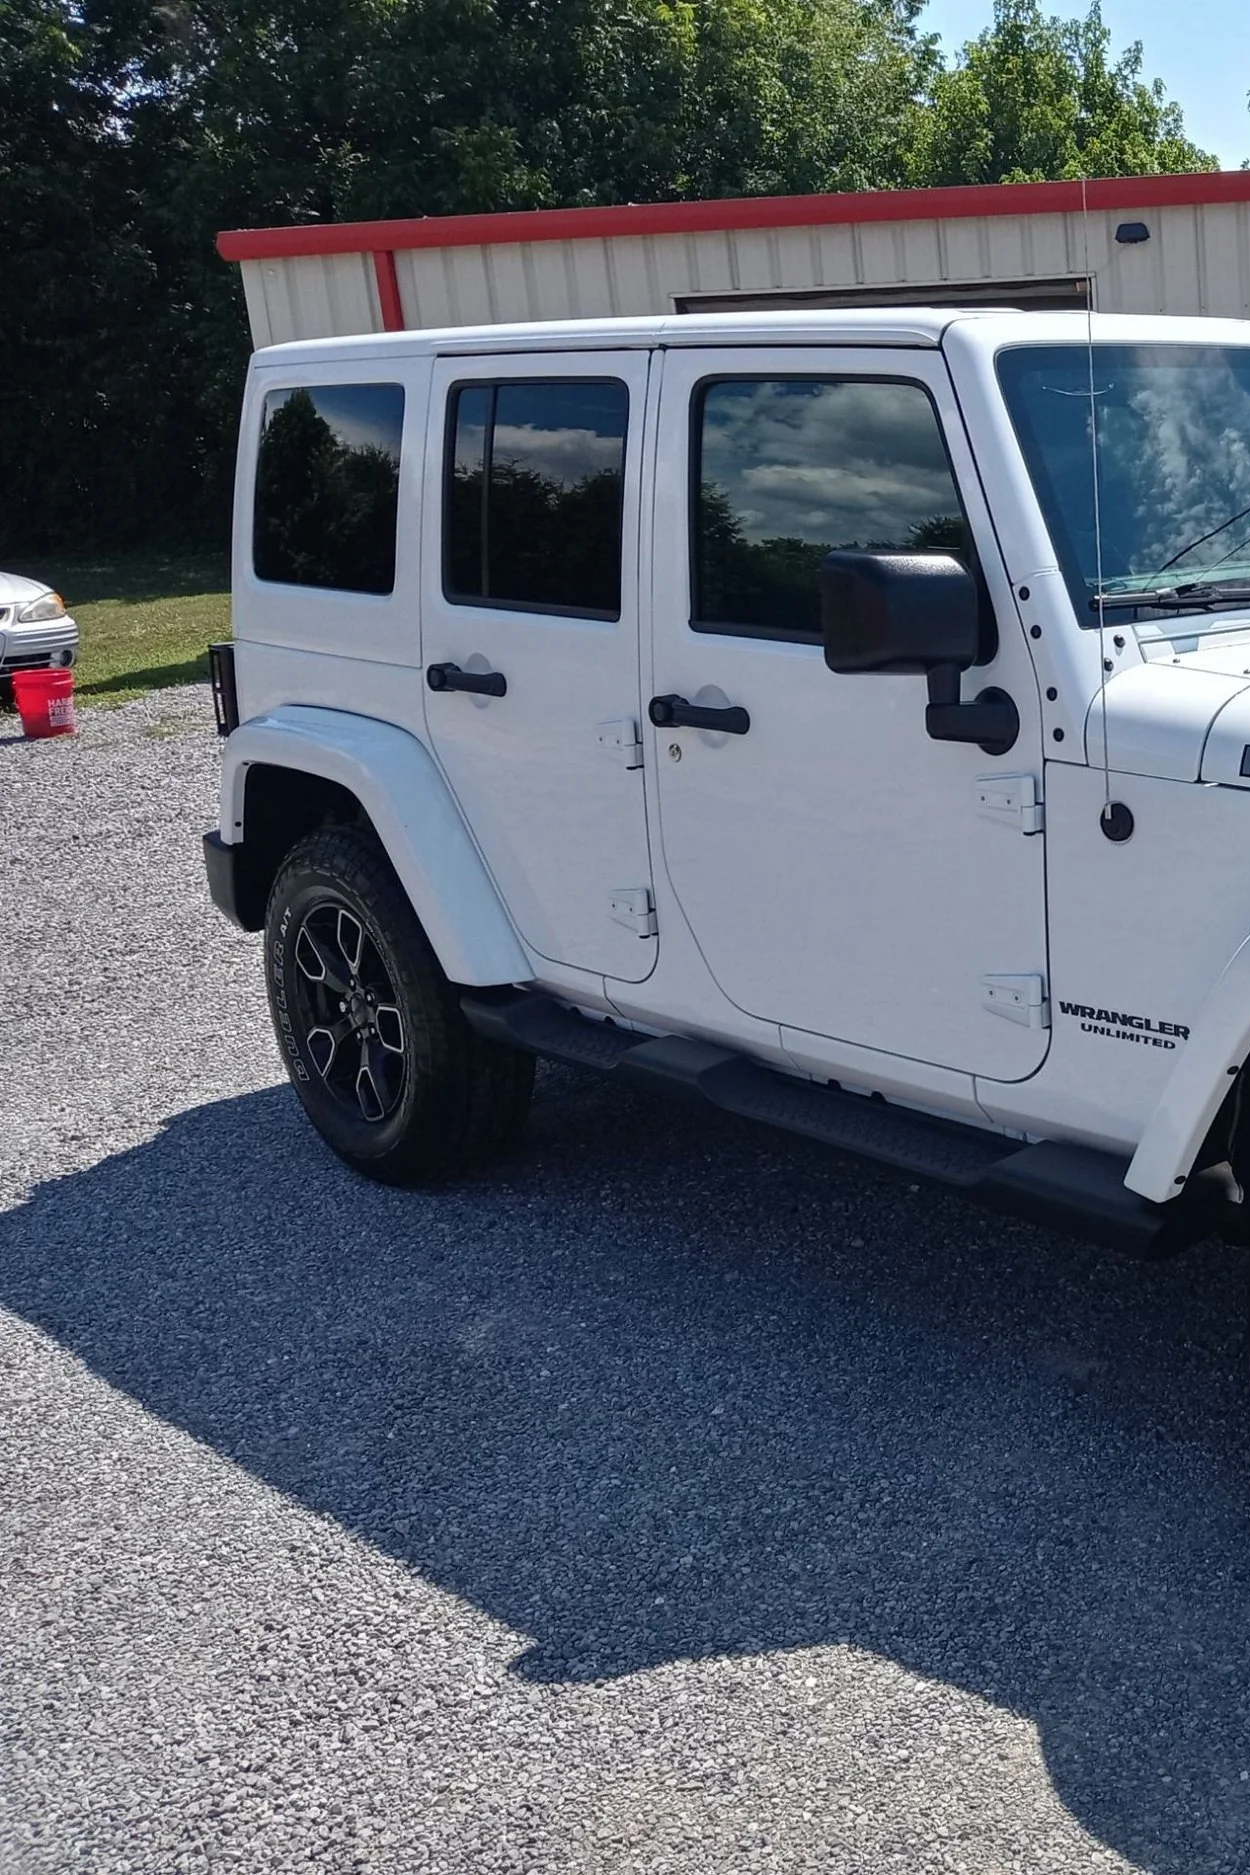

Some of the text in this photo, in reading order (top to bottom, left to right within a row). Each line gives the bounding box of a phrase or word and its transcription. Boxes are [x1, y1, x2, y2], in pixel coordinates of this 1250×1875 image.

[273, 940, 310, 1081] DUELER
[1059, 1000, 1190, 1041] WRANGLER
[1080, 1022, 1176, 1050] UNLIMITED
